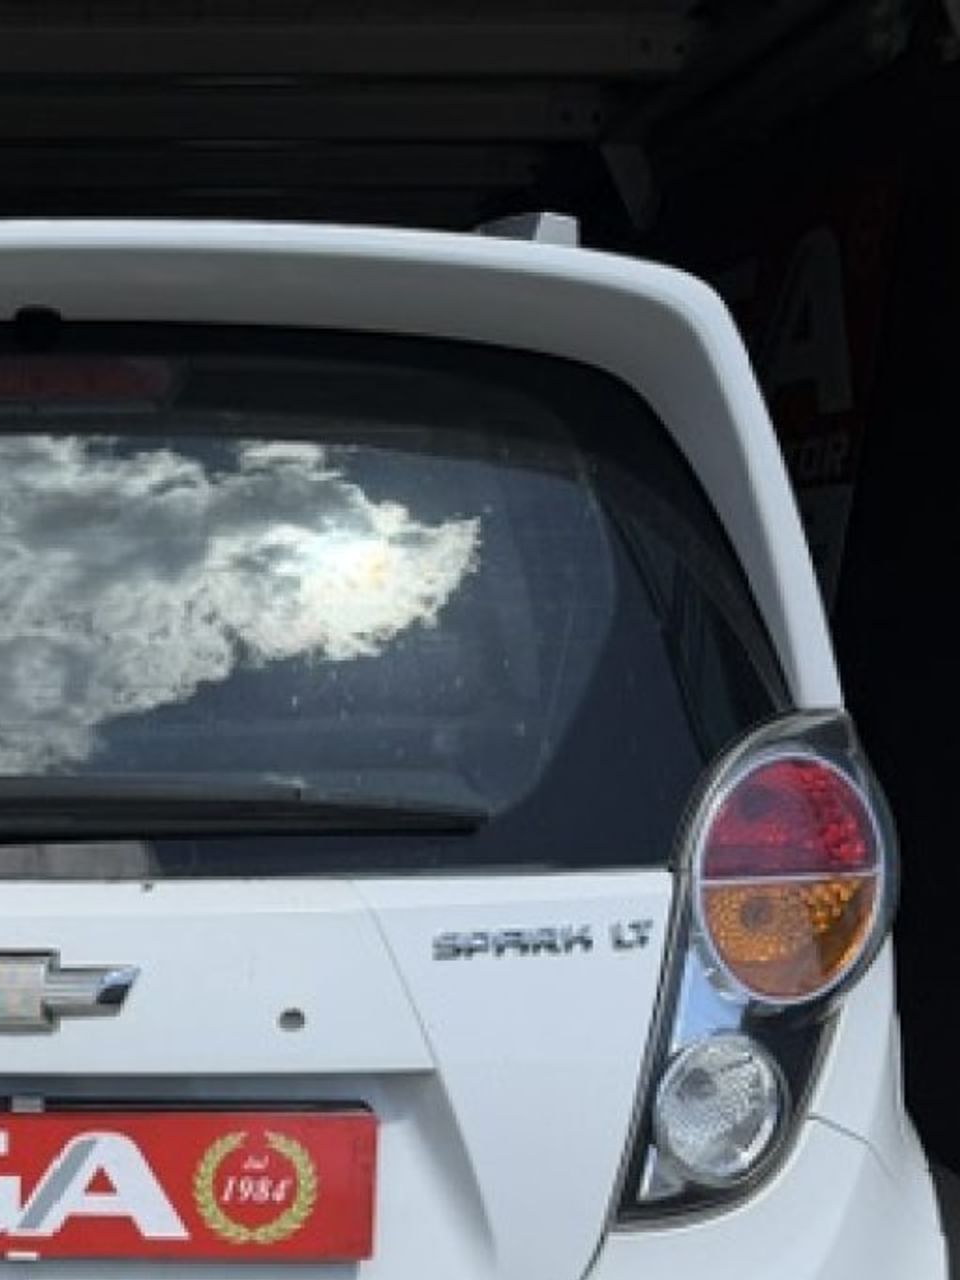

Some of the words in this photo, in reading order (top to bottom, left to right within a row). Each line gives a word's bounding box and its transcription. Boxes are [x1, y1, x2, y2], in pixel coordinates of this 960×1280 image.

[432, 923, 594, 961] SPARK
[608, 919, 654, 949] LT
[221, 1174, 292, 1203] 1984
